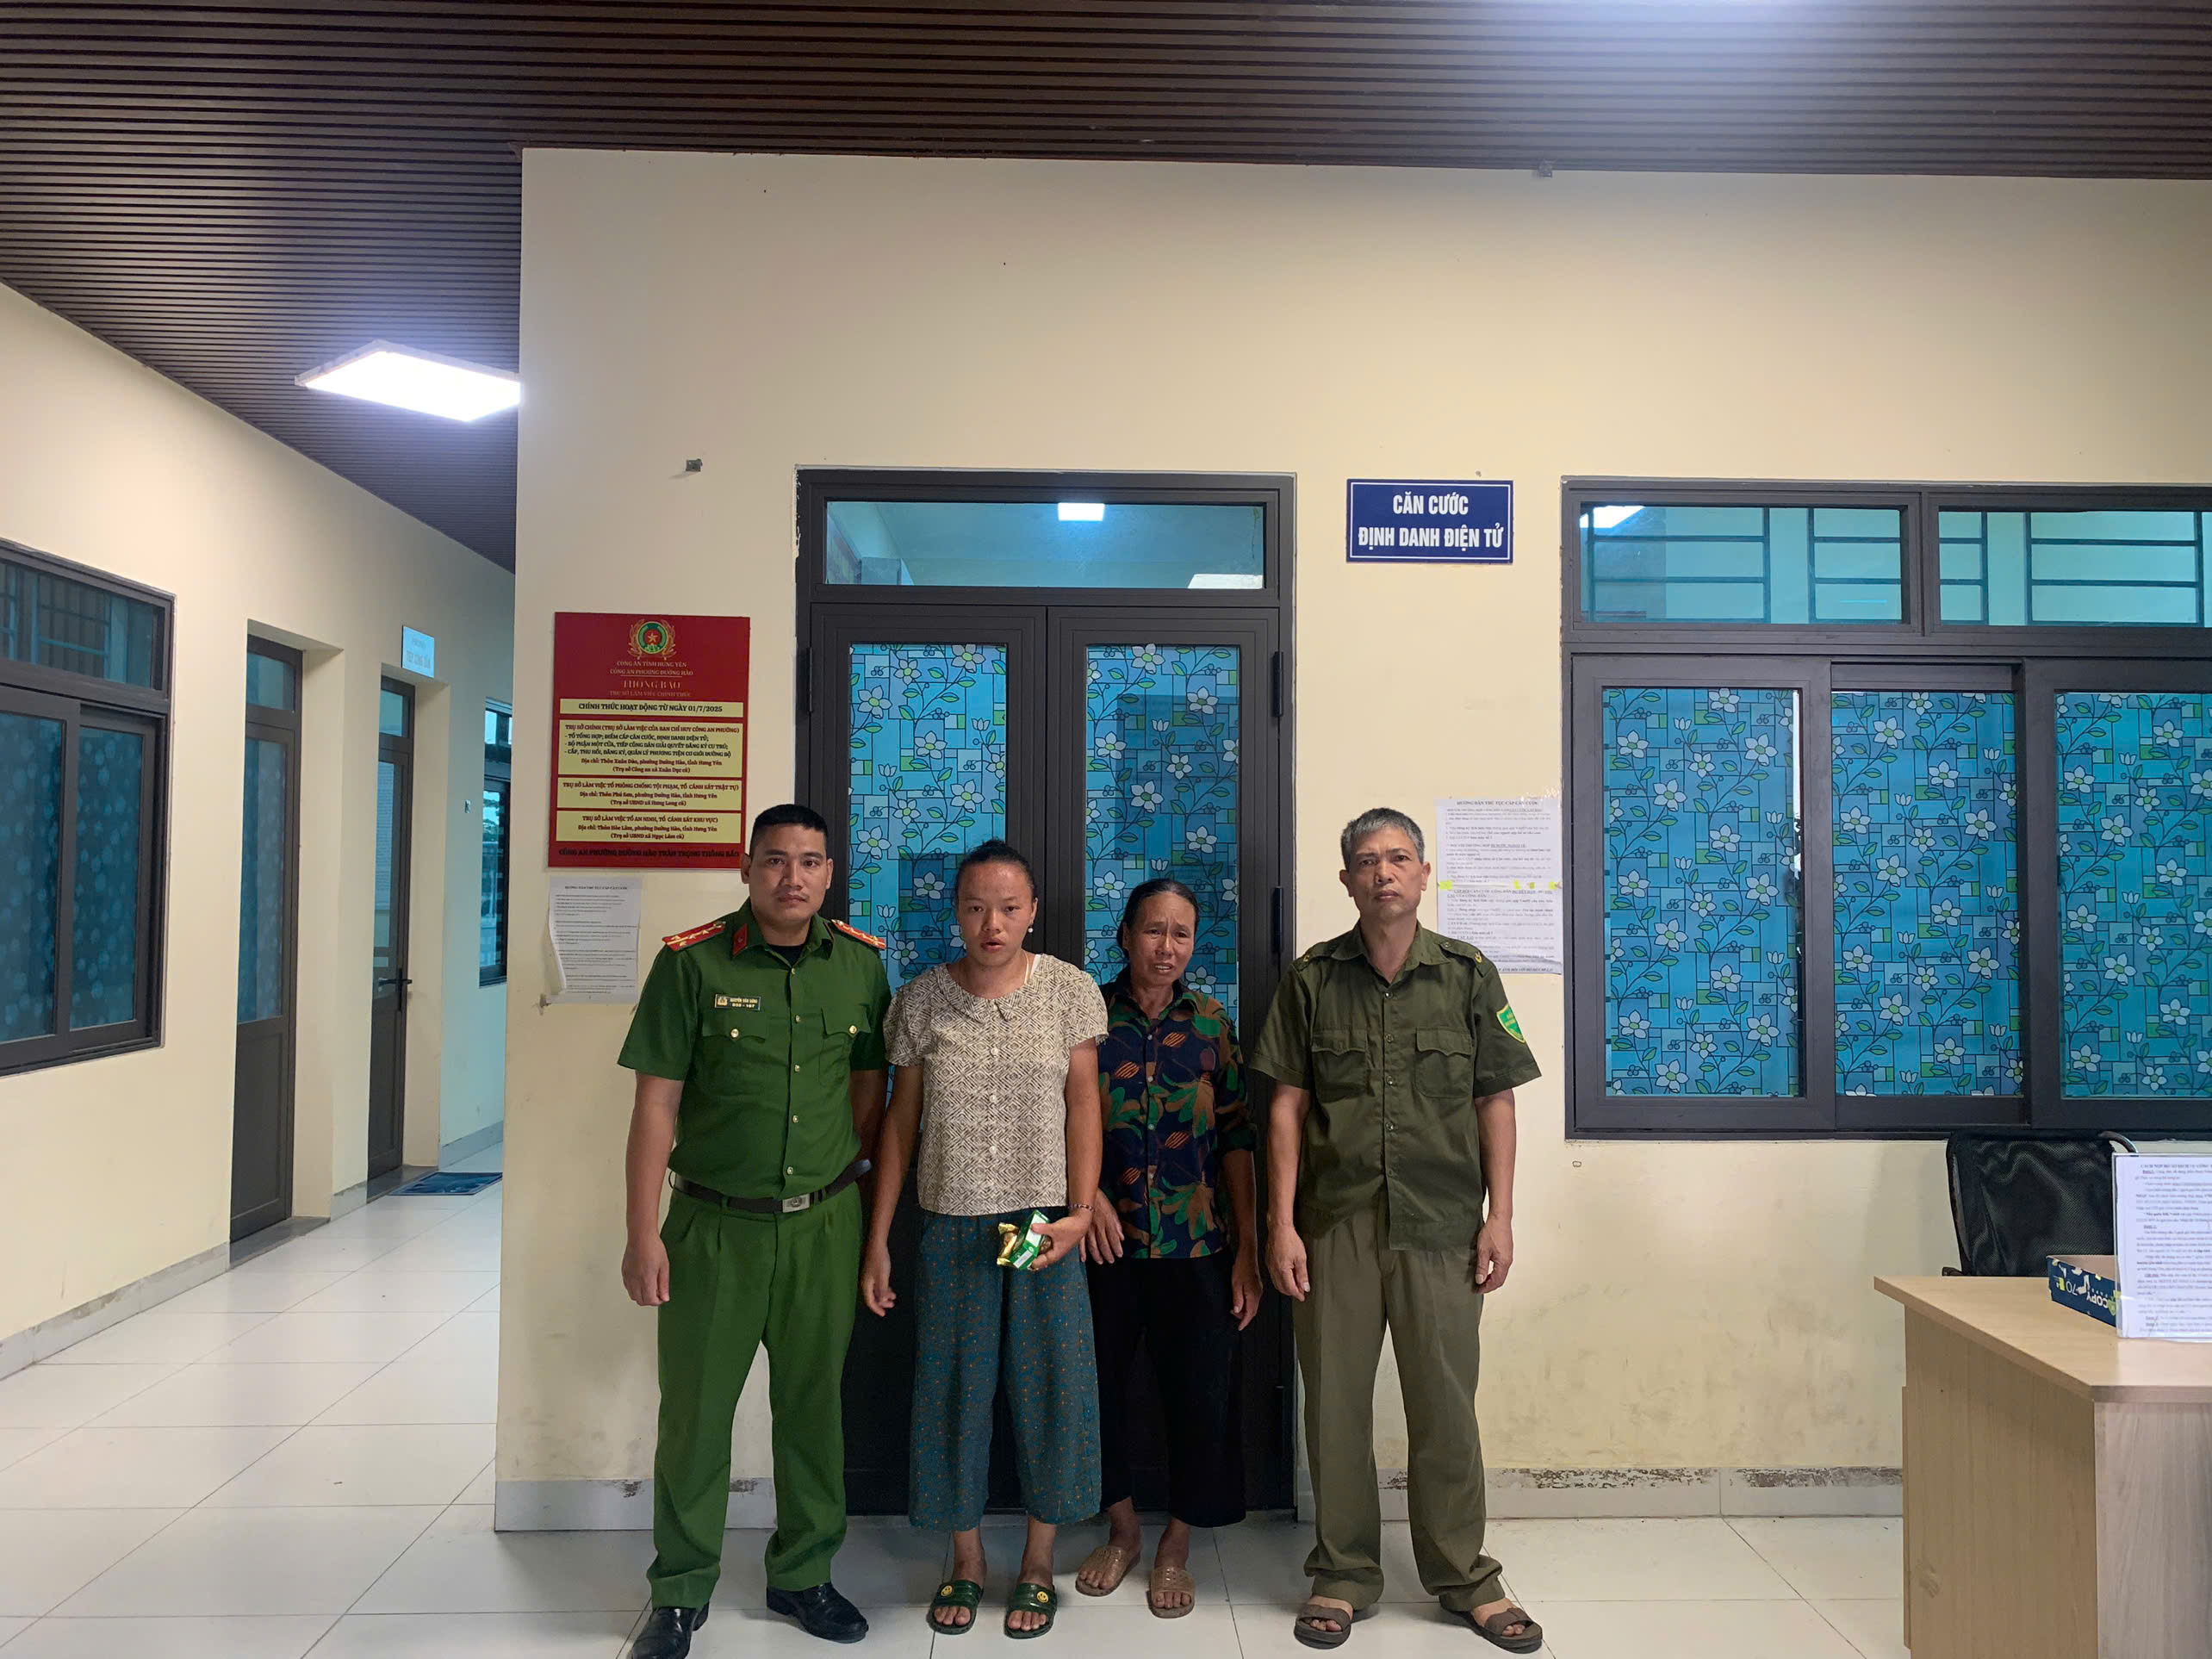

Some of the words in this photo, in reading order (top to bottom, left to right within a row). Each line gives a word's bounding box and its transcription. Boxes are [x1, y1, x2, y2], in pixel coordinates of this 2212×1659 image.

[1393, 491, 1424, 514] CĂN
[1428, 492, 1469, 515] CƯỚC
[1358, 527, 1394, 550] ĐỊNH
[1399, 527, 1439, 547] DANH
[1445, 525, 1480, 551] ĐIỆN
[1484, 523, 1504, 548] TỬ
[639, 703, 657, 711] ĐỘNG
[2086, 1291, 2109, 1308] COPY
